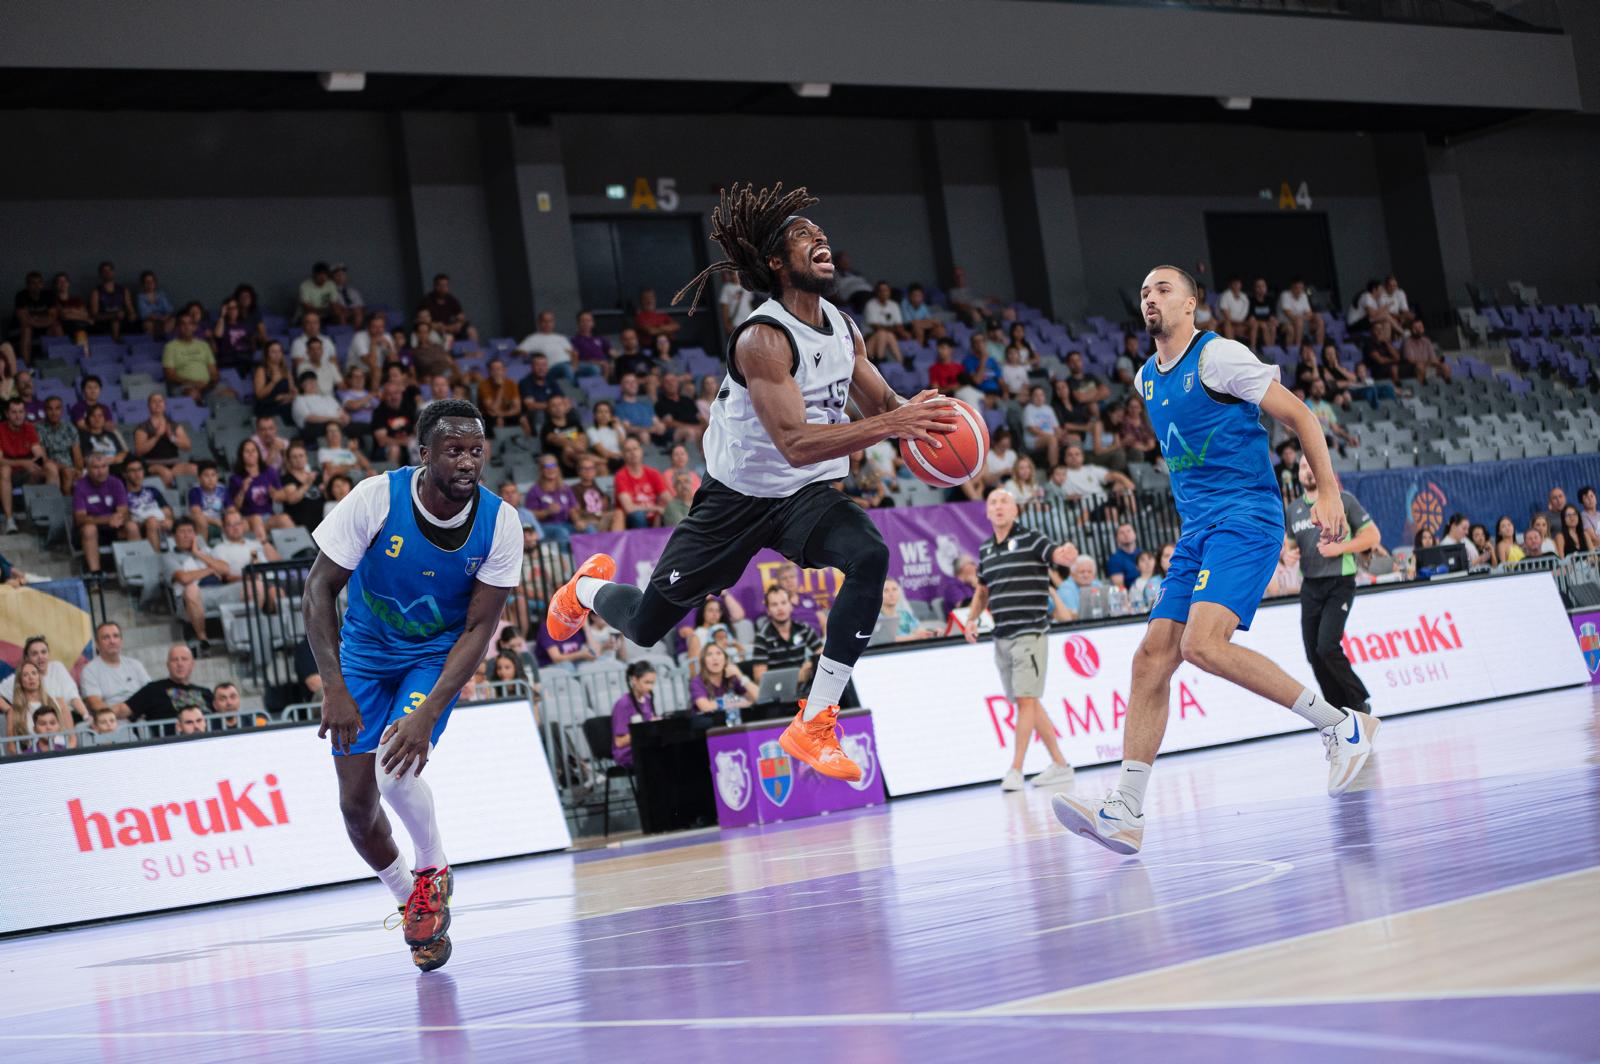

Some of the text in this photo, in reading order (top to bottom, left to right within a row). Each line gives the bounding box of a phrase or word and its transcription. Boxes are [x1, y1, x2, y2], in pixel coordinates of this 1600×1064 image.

[631, 178, 680, 211] A5
[1278, 180, 1313, 210] A4
[1144, 380, 1154, 400] 13
[385, 535, 403, 558] 3
[899, 539, 931, 563] WE
[1342, 610, 1463, 665] haruki
[1385, 661, 1449, 688] SUSHI
[403, 692, 427, 713] 3
[985, 680, 1206, 749] RMAA
[68, 773, 290, 853] haruki
[142, 845, 254, 881] SUSHI
